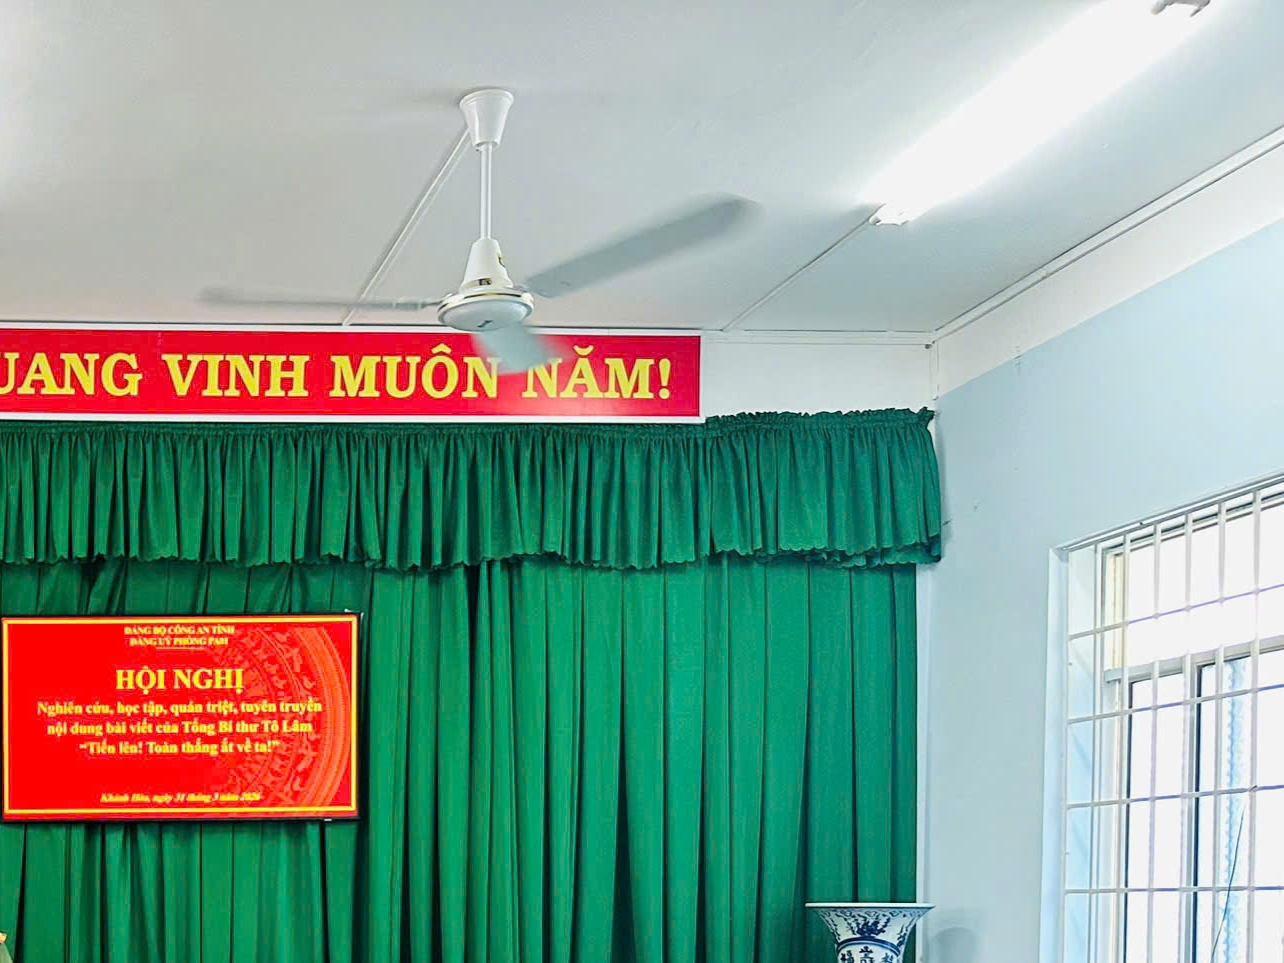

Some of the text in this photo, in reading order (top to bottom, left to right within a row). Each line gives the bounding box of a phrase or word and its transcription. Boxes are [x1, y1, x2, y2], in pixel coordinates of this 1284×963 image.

[162, 353, 308, 398] VINH
[330, 343, 499, 400] MUÔN
[521, 344, 672, 401] NĂM!
[196, 625, 210, 636] AN
[115, 665, 245, 695] HỘI NGHỊ
[36, 697, 323, 717] Nghiên cứu, học tập, quán triệt, tuyên truyền
[47, 717, 314, 738] nội dung bài viết của Tổng Bí thư Tô Lâm
[119, 740, 144, 754] lên!
[146, 740, 179, 754] Toàn
[181, 738, 219, 757] thắng
[236, 736, 252, 753] về
